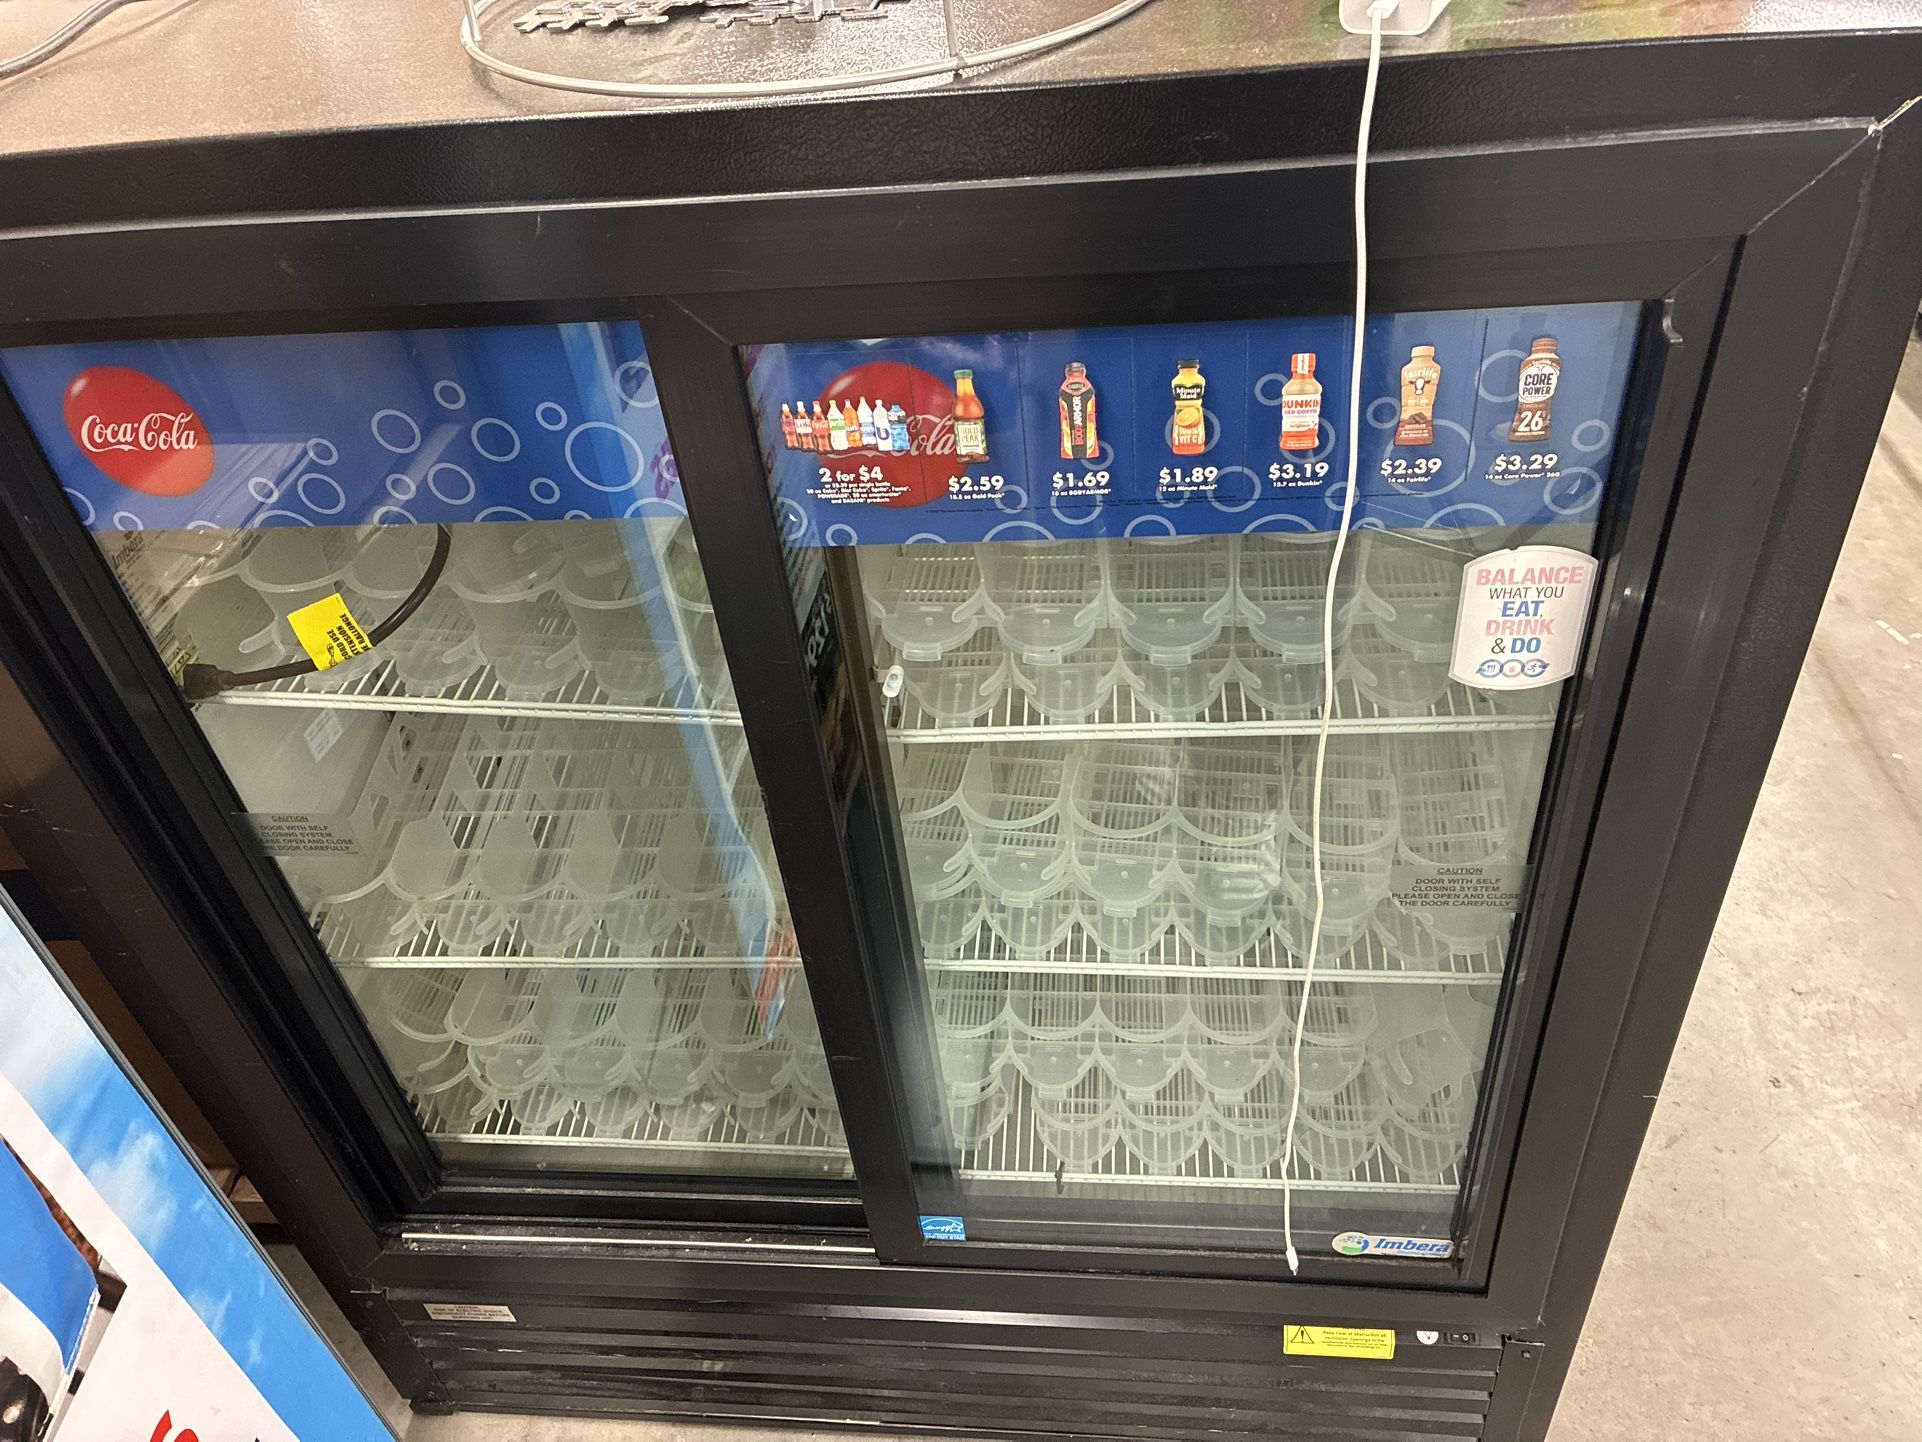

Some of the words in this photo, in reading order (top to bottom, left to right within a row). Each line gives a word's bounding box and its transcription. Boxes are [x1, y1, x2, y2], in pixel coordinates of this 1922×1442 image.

[1524, 372, 1554, 386] CORE
[1522, 386, 1552, 396] POWER
[80, 412, 198, 452] Coca-Cola
[1269, 462, 1329, 481] $3.19
[1380, 458, 1442, 476] $2.39
[1494, 454, 1558, 472] $3.29
[819, 468, 832, 482] 2
[836, 471, 856, 482] for
[858, 465, 883, 482] $4
[1052, 471, 1110, 489] $1.69
[1159, 466, 1218, 484] $1.89
[948, 475, 1004, 493] $2.59
[111, 532, 144, 569] Imbera
[1476, 567, 1585, 586] BALANCE
[1489, 587, 1532, 599] WHAT
[1536, 586, 1564, 599] YOU
[1501, 600, 1544, 619] EAT,
[327, 629, 340, 643] USE
[340, 613, 366, 645] RALLONGE
[1485, 618, 1555, 636] DRINK
[1491, 638, 1506, 654] &
[1510, 637, 1542, 654] DO
[271, 815, 308, 823] CAUTION
[1374, 1239, 1450, 1252] Imbera
